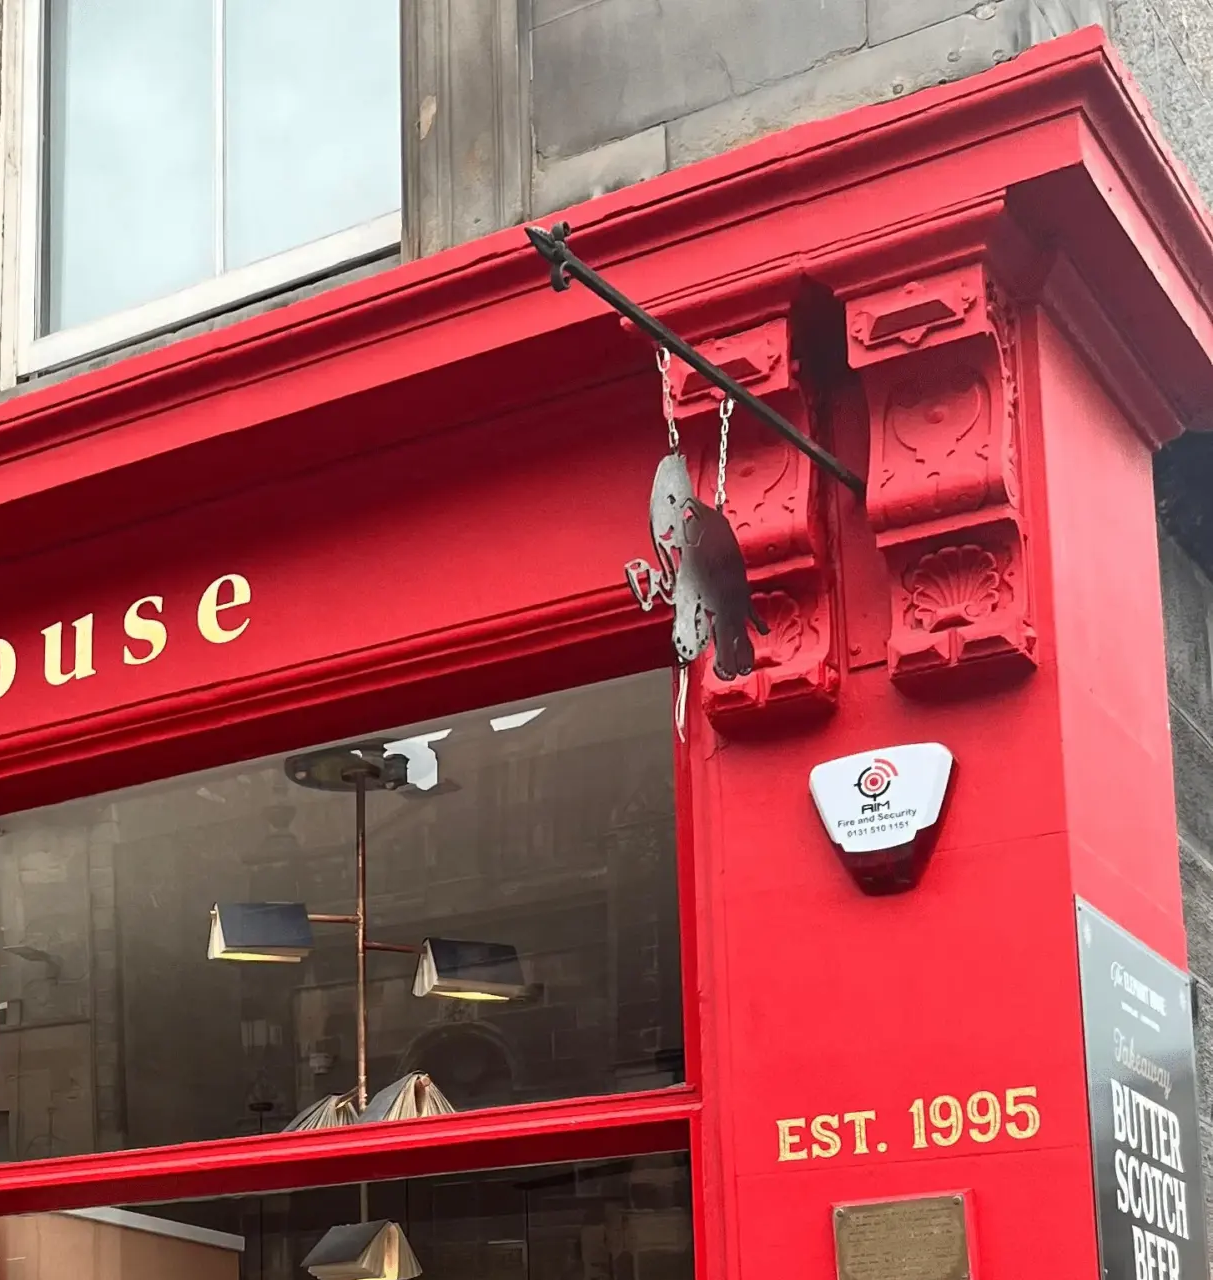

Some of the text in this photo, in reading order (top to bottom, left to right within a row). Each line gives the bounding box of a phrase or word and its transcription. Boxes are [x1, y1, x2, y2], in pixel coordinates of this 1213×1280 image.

[837, 808, 917, 828] Fire and Security
[847, 821, 909, 838] 0131 510 1151
[861, 801, 890, 814] AIM
[775, 1085, 1041, 1162] EST. 1995
[1110, 1078, 1185, 1173] BUTTER
[1115, 1148, 1189, 1240] SCOTCH
